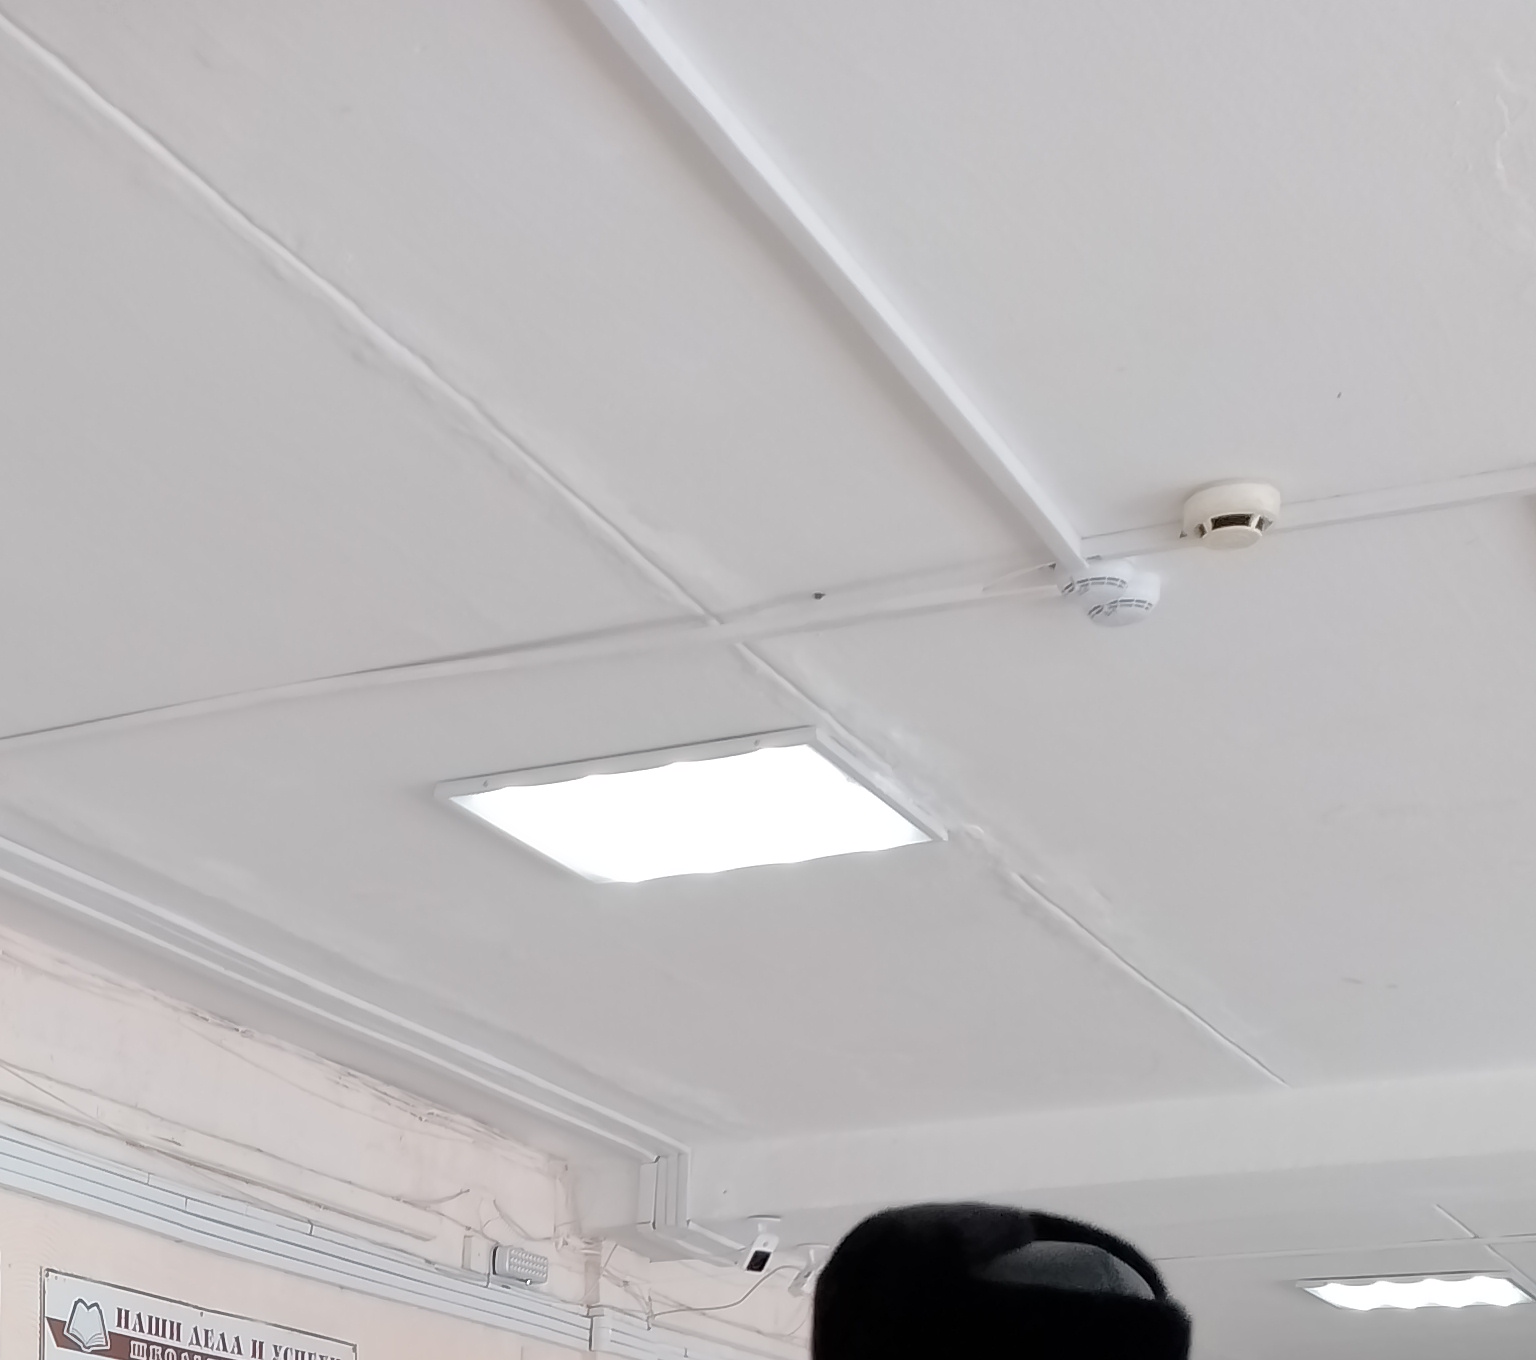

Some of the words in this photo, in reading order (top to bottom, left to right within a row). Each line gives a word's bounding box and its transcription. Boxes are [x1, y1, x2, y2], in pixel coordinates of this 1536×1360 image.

[116, 1306, 183, 1343] НАШИ
[188, 1325, 244, 1357] ДЕЛА
[250, 1339, 265, 1360] И
